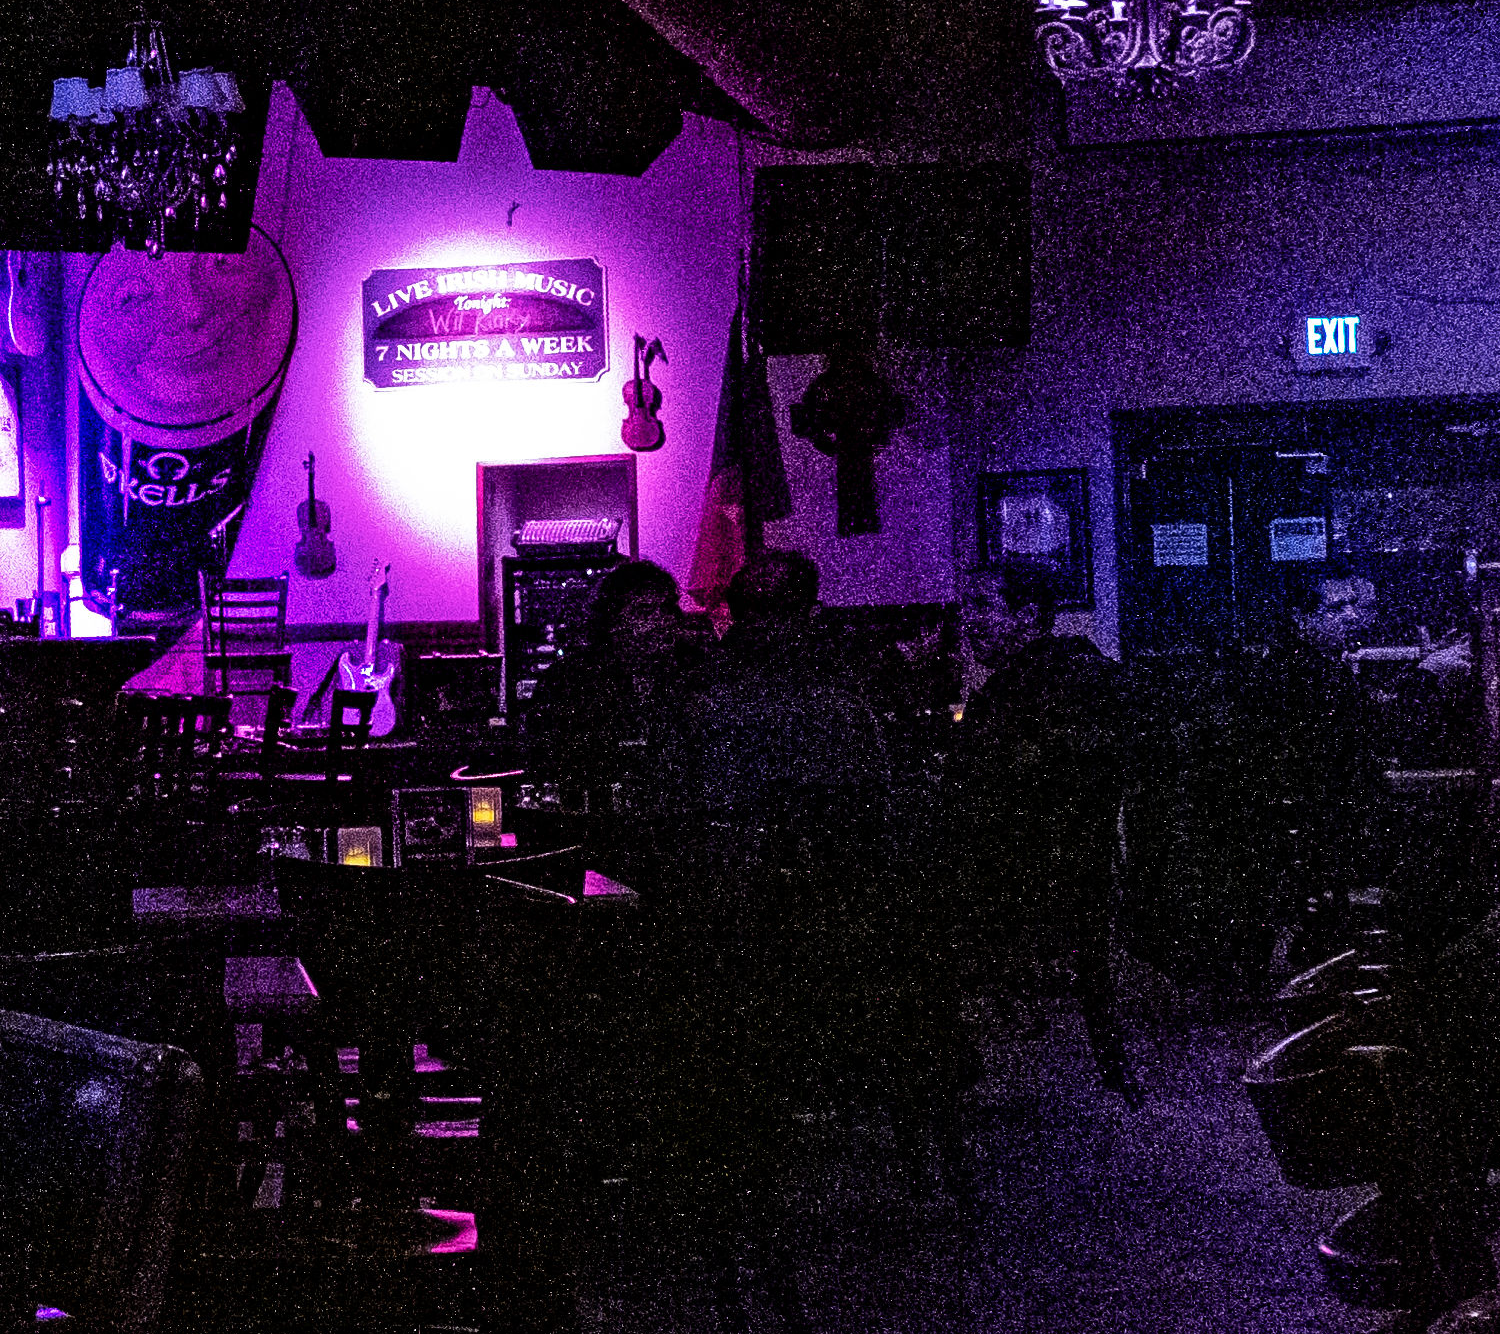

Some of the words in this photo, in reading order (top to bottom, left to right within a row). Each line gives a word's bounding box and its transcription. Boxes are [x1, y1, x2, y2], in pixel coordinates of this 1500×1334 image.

[371, 279, 433, 318] LIVE
[436, 270, 508, 294] IRISH
[512, 271, 595, 307] MUSIC
[375, 345, 388, 362] 7
[396, 340, 490, 362] NIGHTS
[495, 338, 515, 357] A
[521, 335, 595, 355] WEEK
[1306, 316, 1360, 355] EXIT
[391, 365, 471, 383] SESSION
[505, 361, 583, 380] SUNDAY
